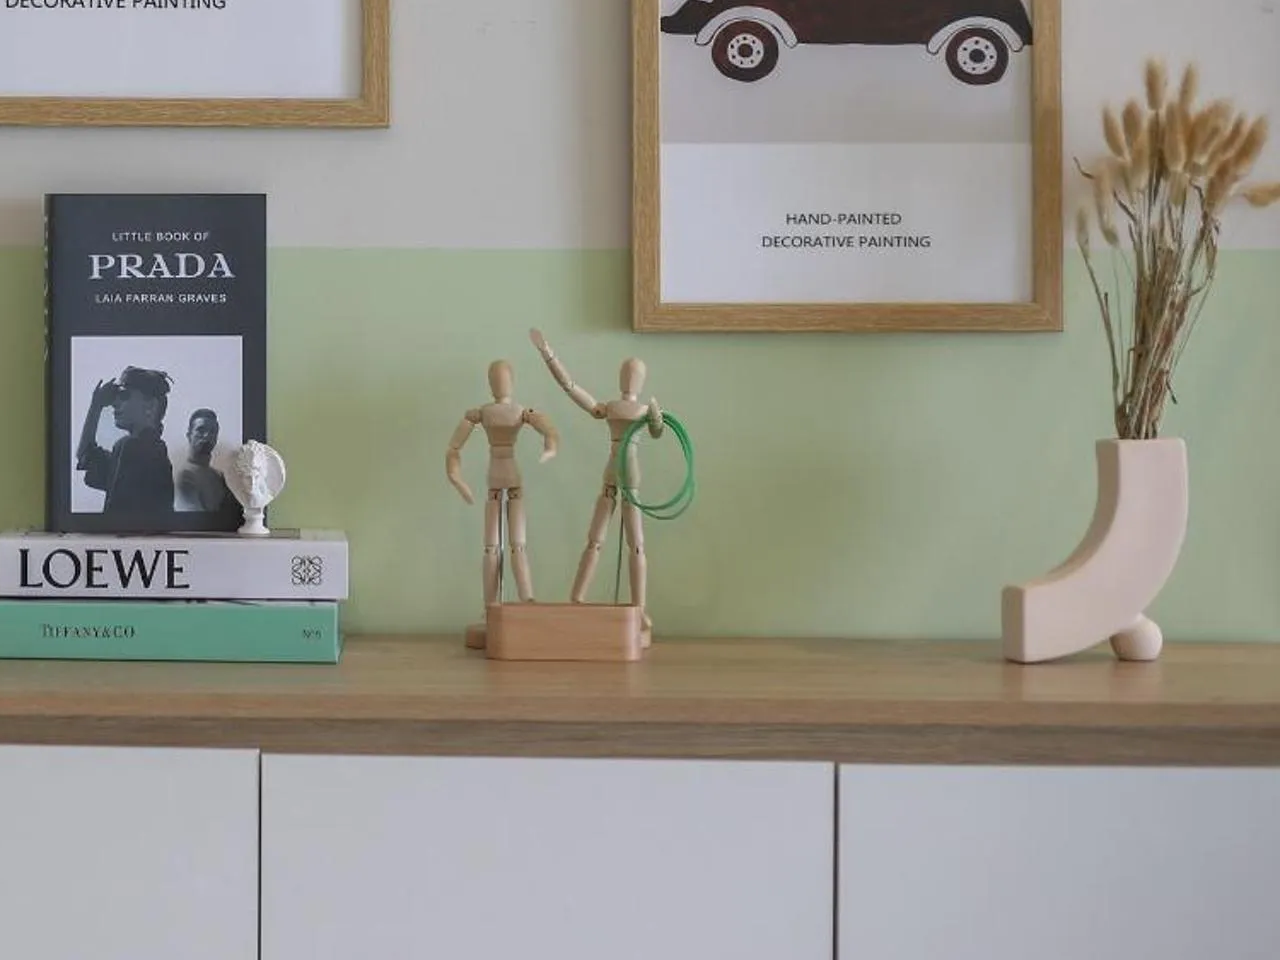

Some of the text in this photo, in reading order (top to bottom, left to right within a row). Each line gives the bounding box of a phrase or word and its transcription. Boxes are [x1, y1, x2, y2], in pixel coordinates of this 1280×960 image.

[785, 212, 903, 226] HAND-PAINTED
[111, 231, 209, 242] LITTLE BOOK OF
[762, 235, 931, 249] DECORATIVE PAINTING
[88, 252, 236, 280] PRADA
[95, 293, 227, 304] LAIA FARRAN GRAVES
[19, 548, 190, 589] LOEWE
